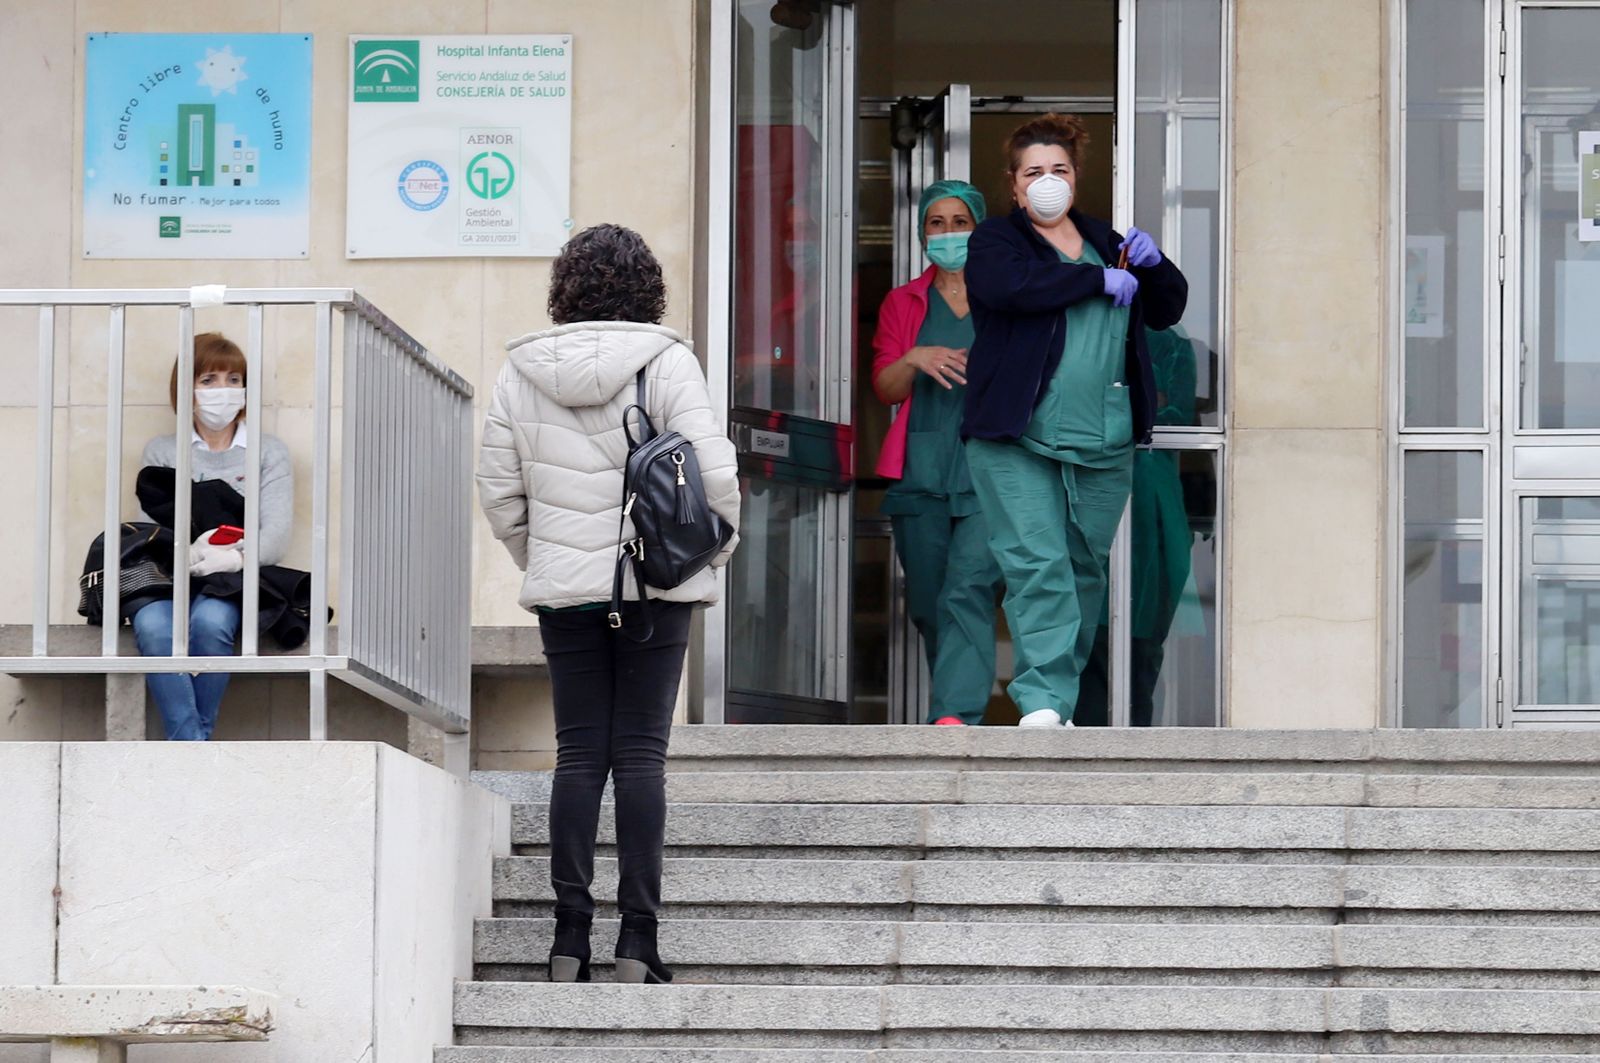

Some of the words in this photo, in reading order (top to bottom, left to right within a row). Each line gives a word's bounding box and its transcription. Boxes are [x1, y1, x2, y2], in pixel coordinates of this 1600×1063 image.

[437, 45, 484, 59] Hospital
[488, 45, 529, 57] Infanta
[533, 45, 565, 57] Elena
[437, 71, 476, 82] Servicio
[479, 71, 519, 82] Andaluz
[522, 71, 535, 82] de
[538, 71, 566, 82] Salud
[437, 85, 505, 97] CONSEJERÍA
[510, 87, 525, 97] DE
[529, 86, 566, 97] SALUD
[114, 97, 139, 151] Centro
[139, 63, 182, 93] libre
[256, 87, 270, 105] de
[269, 110, 284, 151] humo
[467, 134, 513, 145] AENOR
[113, 193, 132, 206] No
[140, 193, 187, 206] fumar
[199, 197, 226, 208] Mejor
[229, 198, 251, 208] para
[254, 197, 280, 206] todos
[465, 207, 502, 217] Gestión
[465, 217, 513, 227] Ambiental
